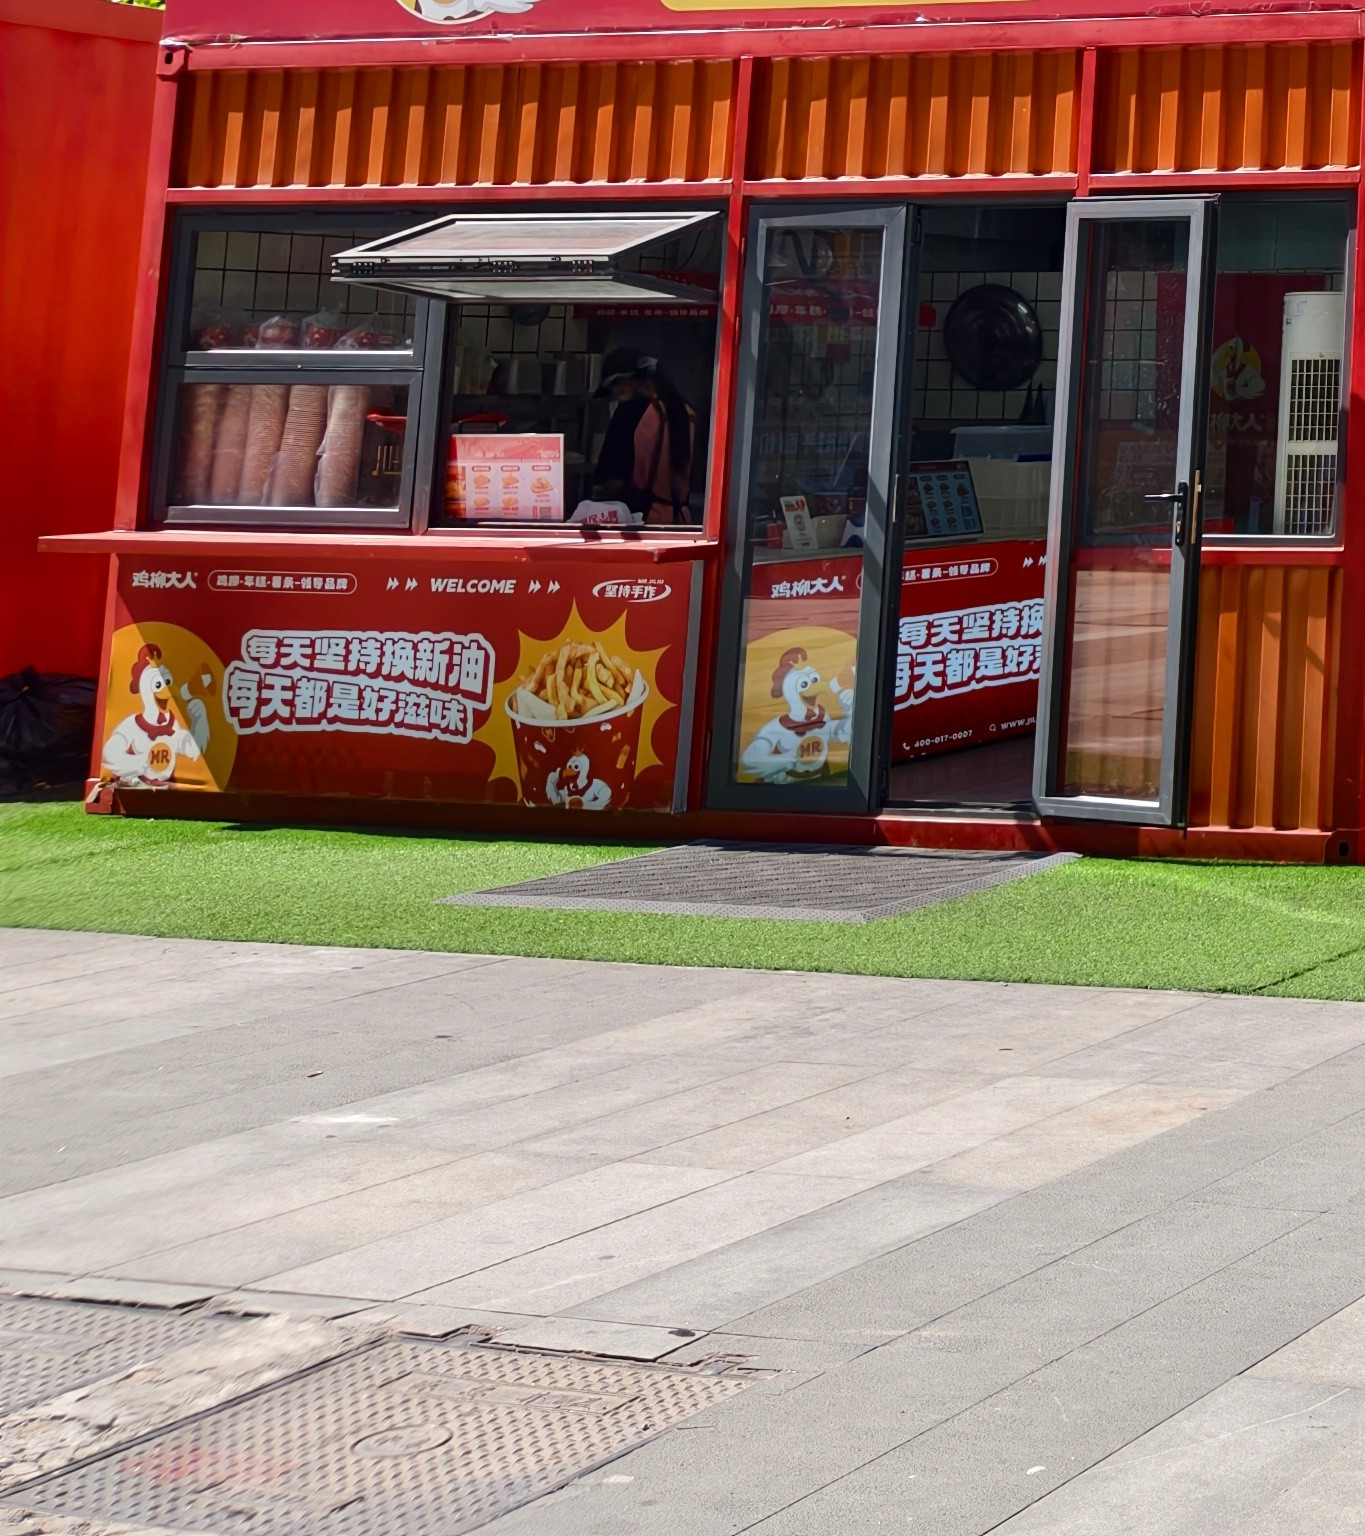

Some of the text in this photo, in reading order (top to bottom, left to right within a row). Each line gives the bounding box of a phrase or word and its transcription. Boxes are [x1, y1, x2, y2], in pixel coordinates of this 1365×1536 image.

[132, 570, 197, 590] 鸡柳大人
[430, 577, 517, 594] WELCOME
[771, 576, 844, 599] 鸡柳大人
[604, 584, 657, 598] 坚持手作
[247, 636, 487, 694] 每天坚持换新油
[228, 670, 465, 732] 每天都是好滋味
[150, 747, 172, 766] MR
